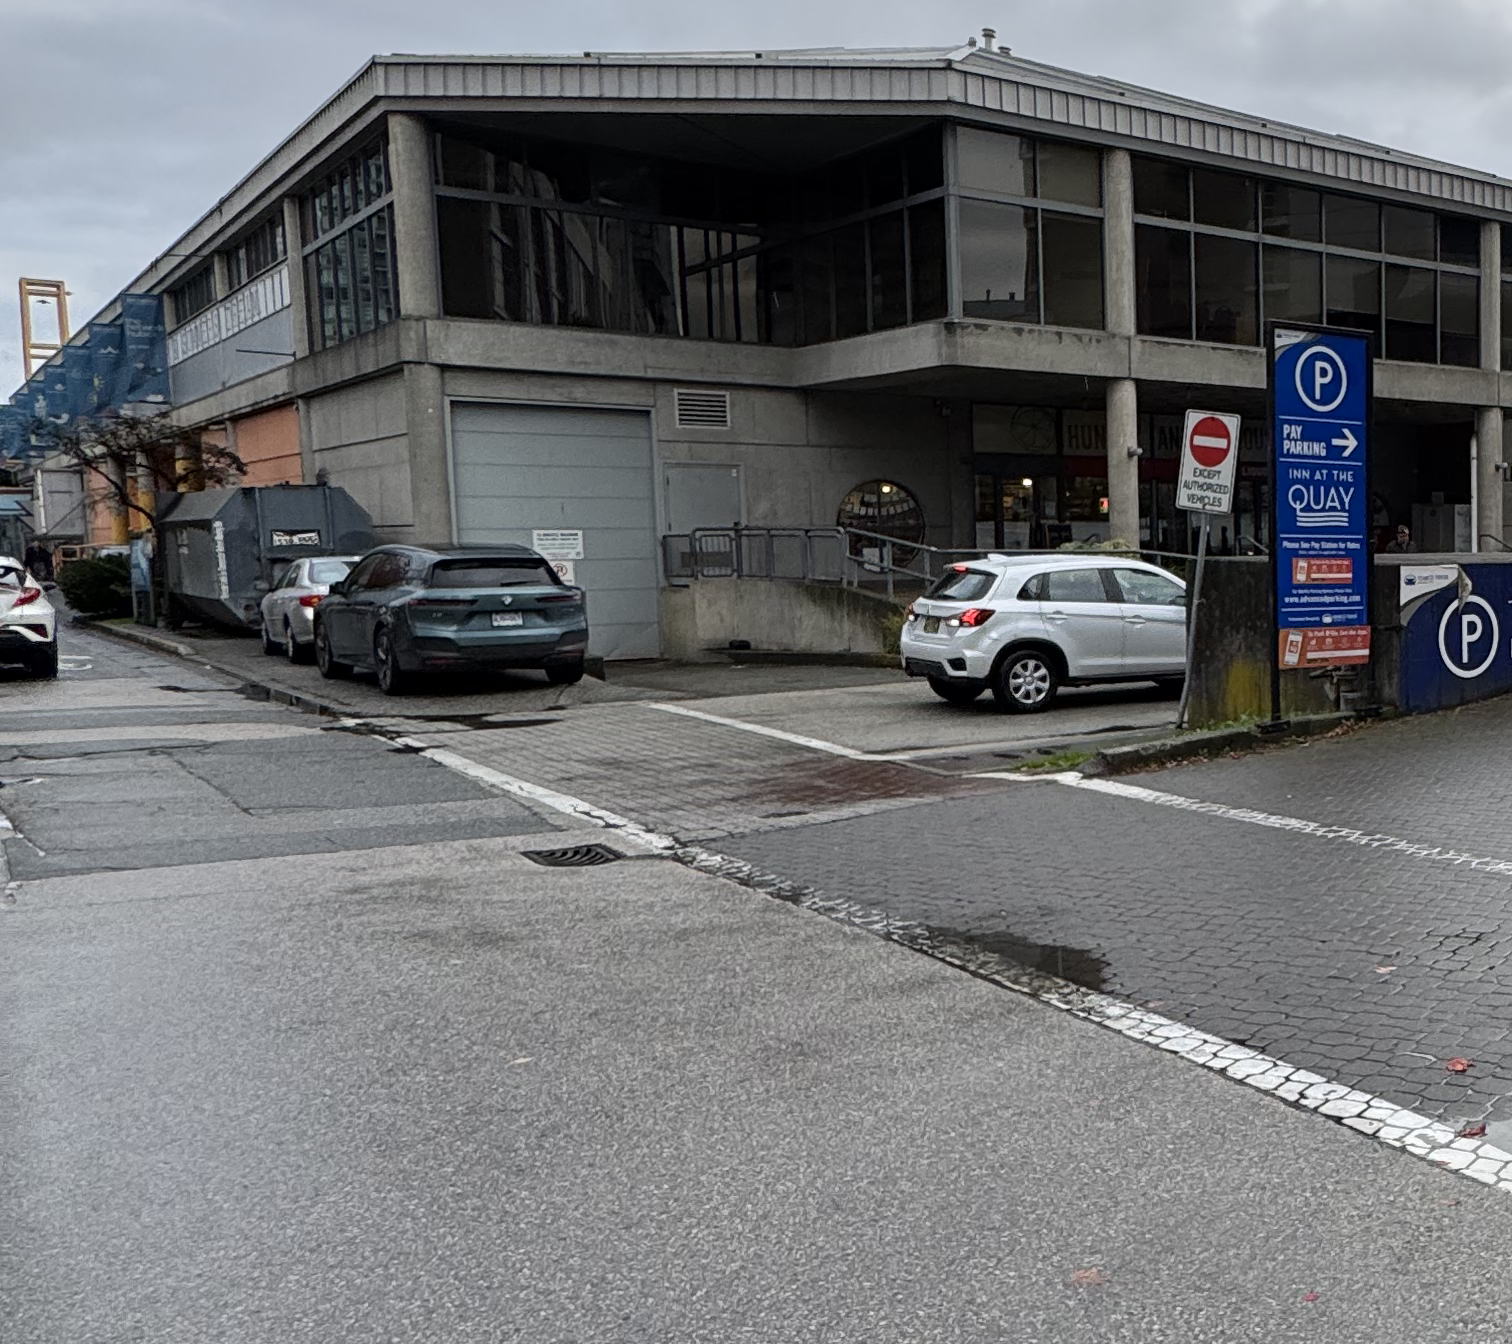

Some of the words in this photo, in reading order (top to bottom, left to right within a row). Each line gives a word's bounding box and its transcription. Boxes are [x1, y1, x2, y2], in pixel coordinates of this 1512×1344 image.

[1314, 360, 1333, 400] P
[1283, 424, 1302, 439] PAY
[1283, 440, 1326, 457] PARKING
[1193, 467, 1222, 480] EXCEPT
[1288, 468, 1310, 480] INN
[1314, 469, 1328, 481] AT
[1332, 470, 1354, 482] THE
[1182, 479, 1229, 495] AUTHORIZED
[1186, 493, 1222, 508] VEHICLES
[1288, 484, 1355, 512] QUAY
[1461, 613, 1483, 664] P
